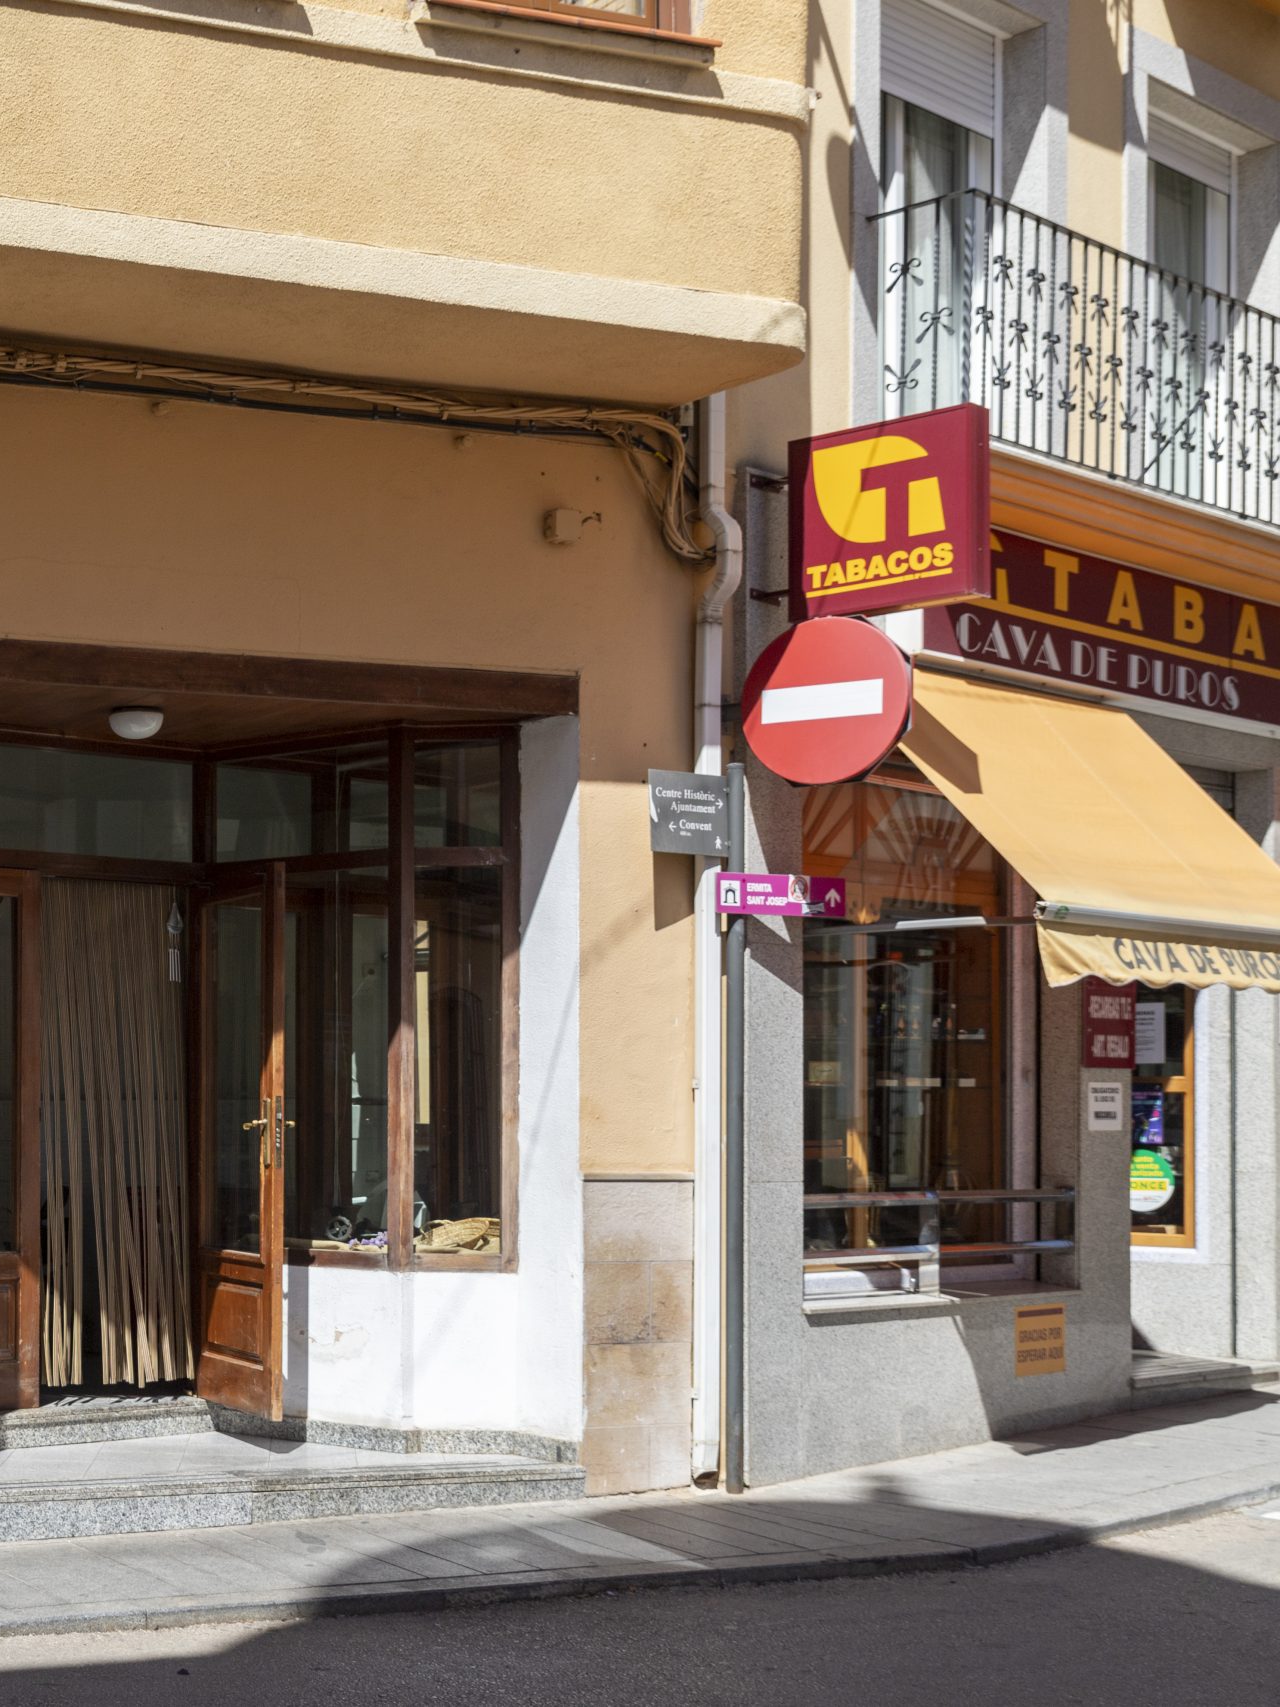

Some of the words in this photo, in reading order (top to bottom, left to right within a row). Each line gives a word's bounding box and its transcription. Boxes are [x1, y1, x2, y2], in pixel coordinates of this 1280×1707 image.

[806, 542, 954, 589] TABACOS
[956, 612, 1062, 672] CAVA
[1070, 640, 1118, 685] DE
[1126, 653, 1241, 711] PUROS
[655, 786, 682, 798] Centre
[684, 789, 716, 801] Històric
[670, 801, 716, 814] Ajuntament
[679, 819, 712, 831] Convent
[746, 882, 772, 893] ERMITA
[746, 896, 765, 905] SANT
[766, 896, 788, 906] JOSEP
[1113, 937, 1188, 973] CAVA
[1186, 944, 1222, 975] DE
[1220, 946, 1280, 981] PURO
[1019, 1328, 1047, 1343] GRACIAS
[1048, 1327, 1062, 1340] POR
[1017, 1347, 1046, 1363] ESPERAR
